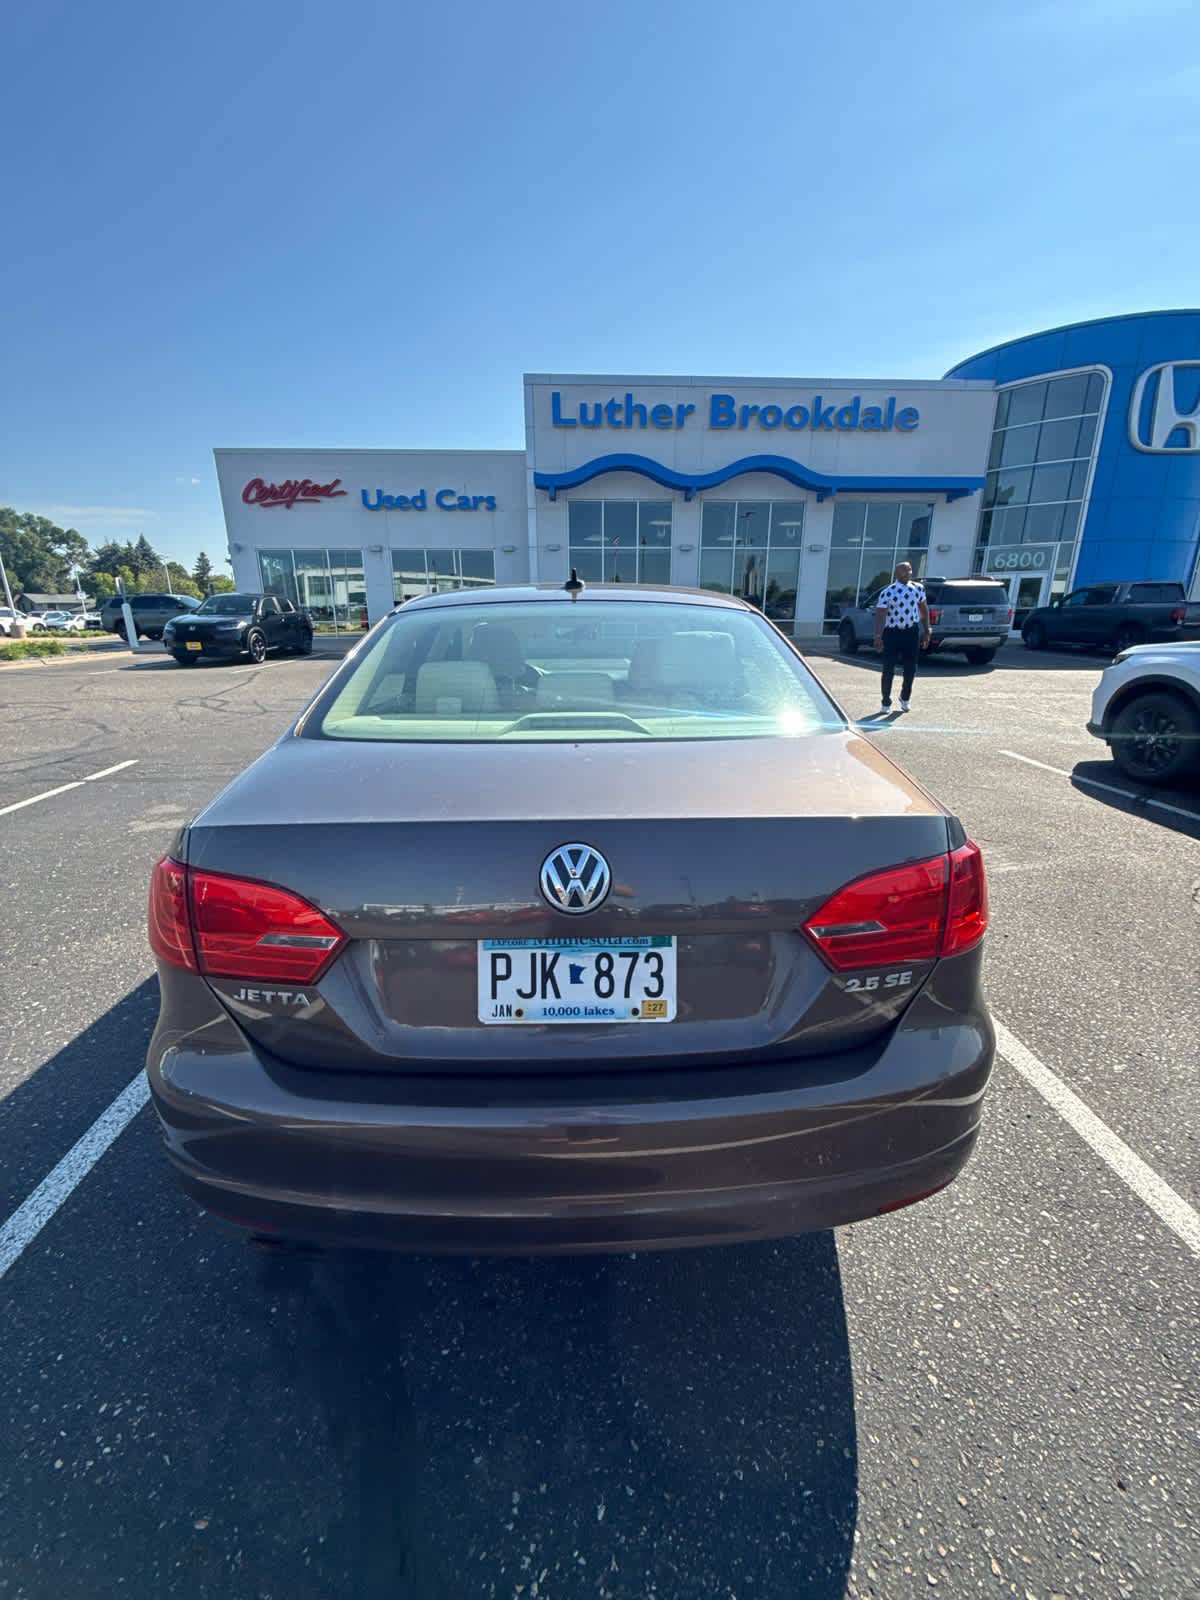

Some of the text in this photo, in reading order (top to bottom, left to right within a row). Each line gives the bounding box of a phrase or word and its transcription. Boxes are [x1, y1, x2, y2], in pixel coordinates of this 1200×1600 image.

[551, 391, 920, 431] Luther Brookdale
[242, 477, 348, 509] Certified
[361, 488, 497, 511] Used Cars
[994, 551, 1045, 569] 6800
[490, 951, 664, 1000] PJK 873
[883, 971, 913, 987] SE
[233, 988, 311, 1007] JETTA
[491, 1004, 513, 1017] JAN
[542, 1006, 615, 1017] 10,000 lakes
